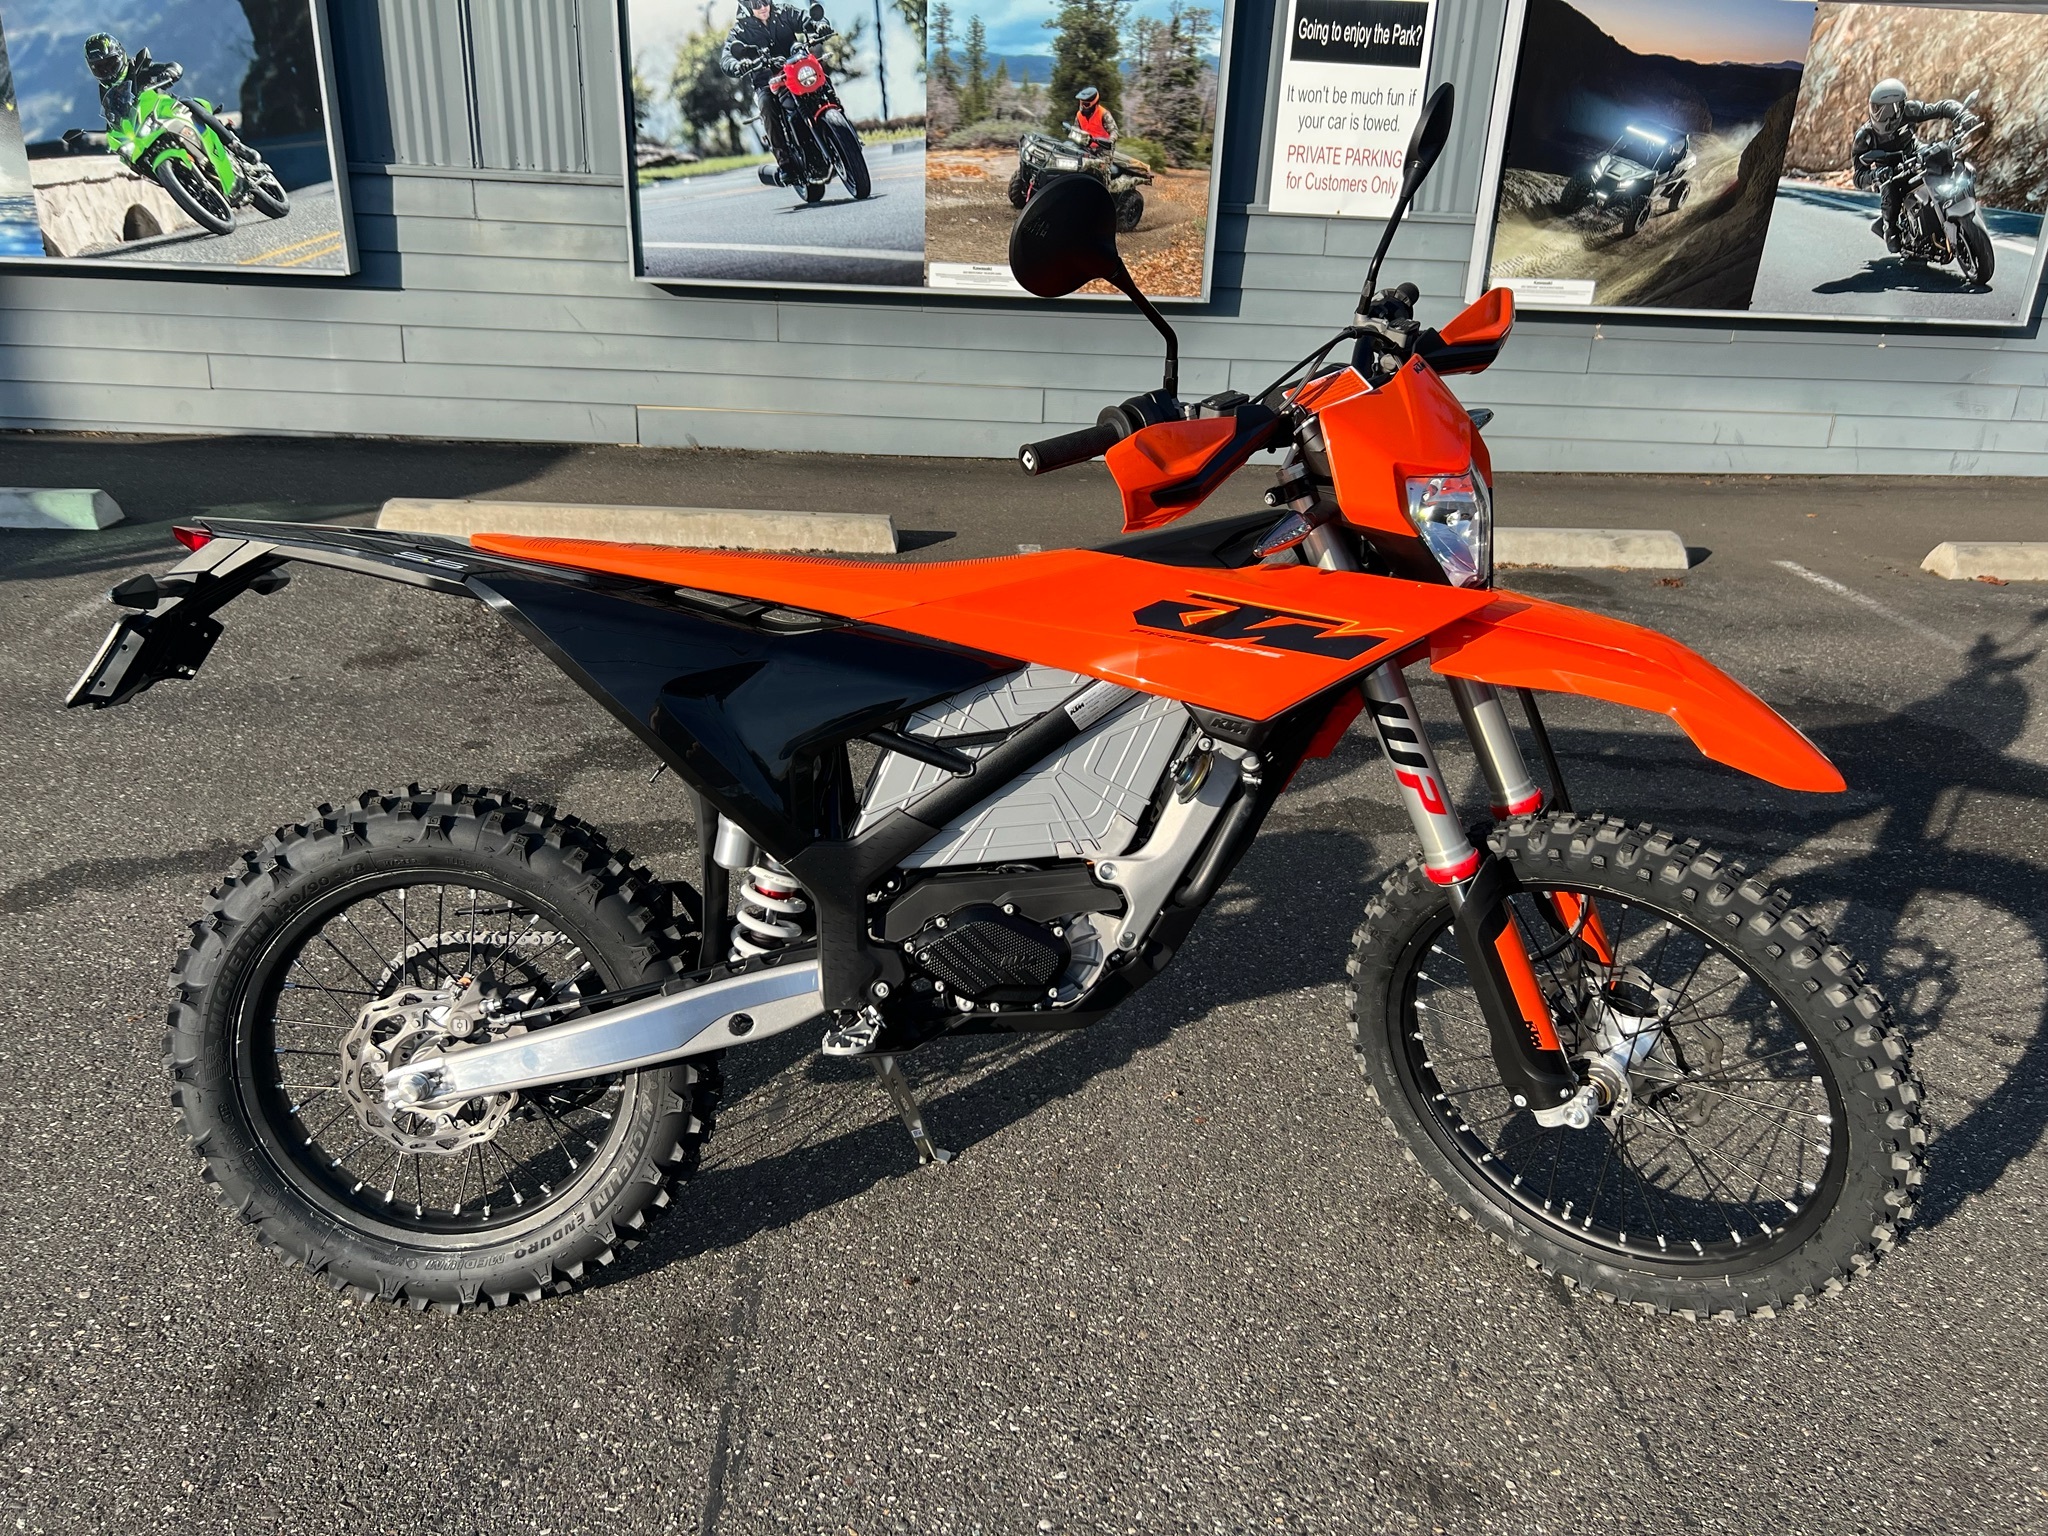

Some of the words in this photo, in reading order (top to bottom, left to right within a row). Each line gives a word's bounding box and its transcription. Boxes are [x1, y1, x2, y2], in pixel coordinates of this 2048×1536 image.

[1298, 17, 1329, 46] Going
[1331, 20, 1342, 42] to
[1343, 21, 1373, 49] enjoy
[1373, 22, 1390, 45] the
[1391, 23, 1423, 46] Park?
[1286, 84, 1295, 102] It
[1297, 85, 1329, 104] won't
[1332, 86, 1348, 104] be
[1350, 87, 1384, 106] much
[1387, 88, 1405, 106] fun
[1408, 88, 1418, 107] if
[1298, 114, 1325, 133] your
[1327, 115, 1347, 130] car
[1349, 112, 1360, 130] is
[1363, 114, 1400, 132] towed.
[1286, 144, 1342, 165] PRIVATE
[1345, 147, 1403, 169] PARKING
[1286, 171, 1302, 190] for
[1305, 172, 1368, 193] Customers
[1371, 175, 1399, 199] Only
[1132, 592, 1390, 661] KTM
[1129, 628, 1285, 659] FREERIDE
[1210, 717, 1250, 736] KTM
[209, 917, 271, 1034] MICHELIN
[593, 1092, 654, 1213] MICHELIN
[514, 1211, 586, 1259] ENDURO
[425, 1253, 505, 1271] MEDIUM
